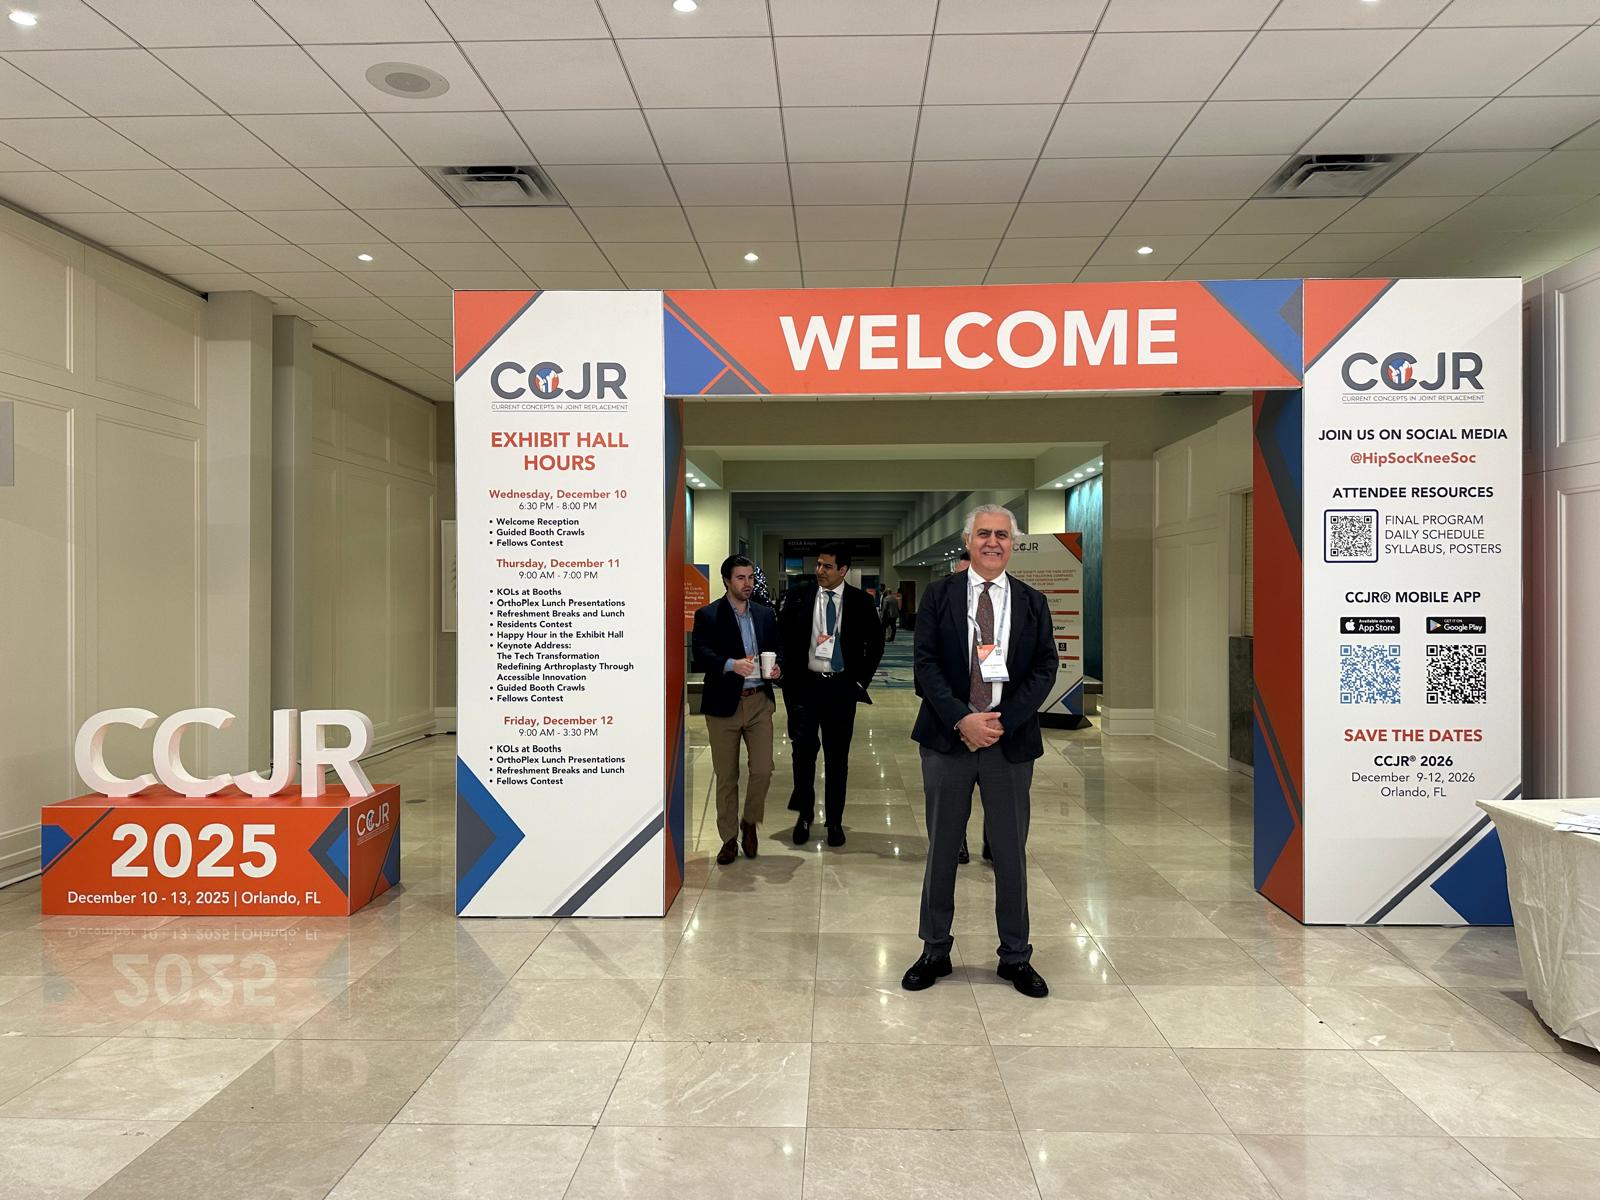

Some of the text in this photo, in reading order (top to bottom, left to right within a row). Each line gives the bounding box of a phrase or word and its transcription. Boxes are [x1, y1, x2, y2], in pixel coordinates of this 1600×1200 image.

[779, 308, 1178, 371] WELCOME
[1341, 352, 1485, 391] CCJR
[490, 361, 628, 400] CCJR
[491, 432, 629, 448] EXHIBIT HALL
[1318, 428, 1508, 441] JOIN US ON SOCIAL MEDIA
[524, 455, 596, 471] HOURS
[1350, 451, 1476, 467] @HipSocKneeSoc
[489, 489, 627, 501] Wednesday, December 10
[1332, 486, 1494, 498] ATTENDEE RESOURCES
[518, 502, 538, 510] 6:30
[540, 502, 554, 510] PM
[562, 501, 581, 510] 8:00
[583, 502, 597, 510] PM
[496, 517, 579, 527] Welcome Reception
[1385, 514, 1483, 525] FINAL PROGRAM
[529, 528, 554, 536] Booth
[1385, 529, 1485, 540] DAILY SCHEDULE
[496, 539, 563, 547] Fellows Contest
[1385, 543, 1502, 555] SYLLABUS, POSTERS
[496, 558, 619, 570] Thursday, December 11
[518, 571, 538, 579] 9:00
[539, 571, 555, 579] AM
[563, 571, 582, 580] 7:00
[584, 571, 598, 579] PM
[532, 588, 562, 596] Booths
[1396, 591, 1449, 603] MOBILE
[1453, 591, 1481, 603] APP
[496, 598, 626, 607] OrthoPlex Lunch Presentations
[497, 609, 550, 617] Refreshment
[552, 609, 580, 617] Breaks
[582, 609, 598, 617] and
[497, 620, 537, 628] Residents
[1358, 624, 1375, 632] App
[1444, 623, 1482, 632] Google Play
[497, 631, 524, 641] Happy
[576, 630, 605, 638] Exhibit
[607, 630, 624, 638] Hall
[497, 641, 571, 651] Keynote Address:
[514, 652, 534, 660] Tech
[536, 651, 600, 660] Transformation
[497, 662, 634, 672] Redefining Arthroplasty Through
[496, 673, 540, 681] Accessible
[496, 683, 585, 692] Guided Booth Crawls
[497, 694, 528, 702] Fellows
[504, 715, 613, 728] Friday, December 12
[518, 728, 538, 737] 9:00
[539, 728, 555, 736] AM
[563, 728, 582, 737] 3:30
[584, 728, 598, 736] PM
[1344, 729, 1483, 742] SAVE THE DATES
[74, 707, 376, 797] CCJR
[497, 745, 519, 753] KOLs
[532, 744, 562, 753] Booths
[496, 755, 626, 764] OrthoPlex Lunch Presentations
[1420, 756, 1453, 767] 2026
[496, 765, 625, 774] Refreshment Breaks and Lunch
[496, 777, 528, 785] Fellows
[1352, 772, 1476, 784] December 9-12, 2026
[1380, 786, 1447, 799] Orlando, FL
[356, 802, 389, 836] CCJR
[111, 823, 277, 878] 2025
[68, 891, 136, 904] December
[141, 891, 157, 904] 10
[171, 891, 191, 906] 13,
[196, 891, 229, 904] 2025
[241, 891, 300, 906] Orlando,
[305, 891, 321, 904] FL
